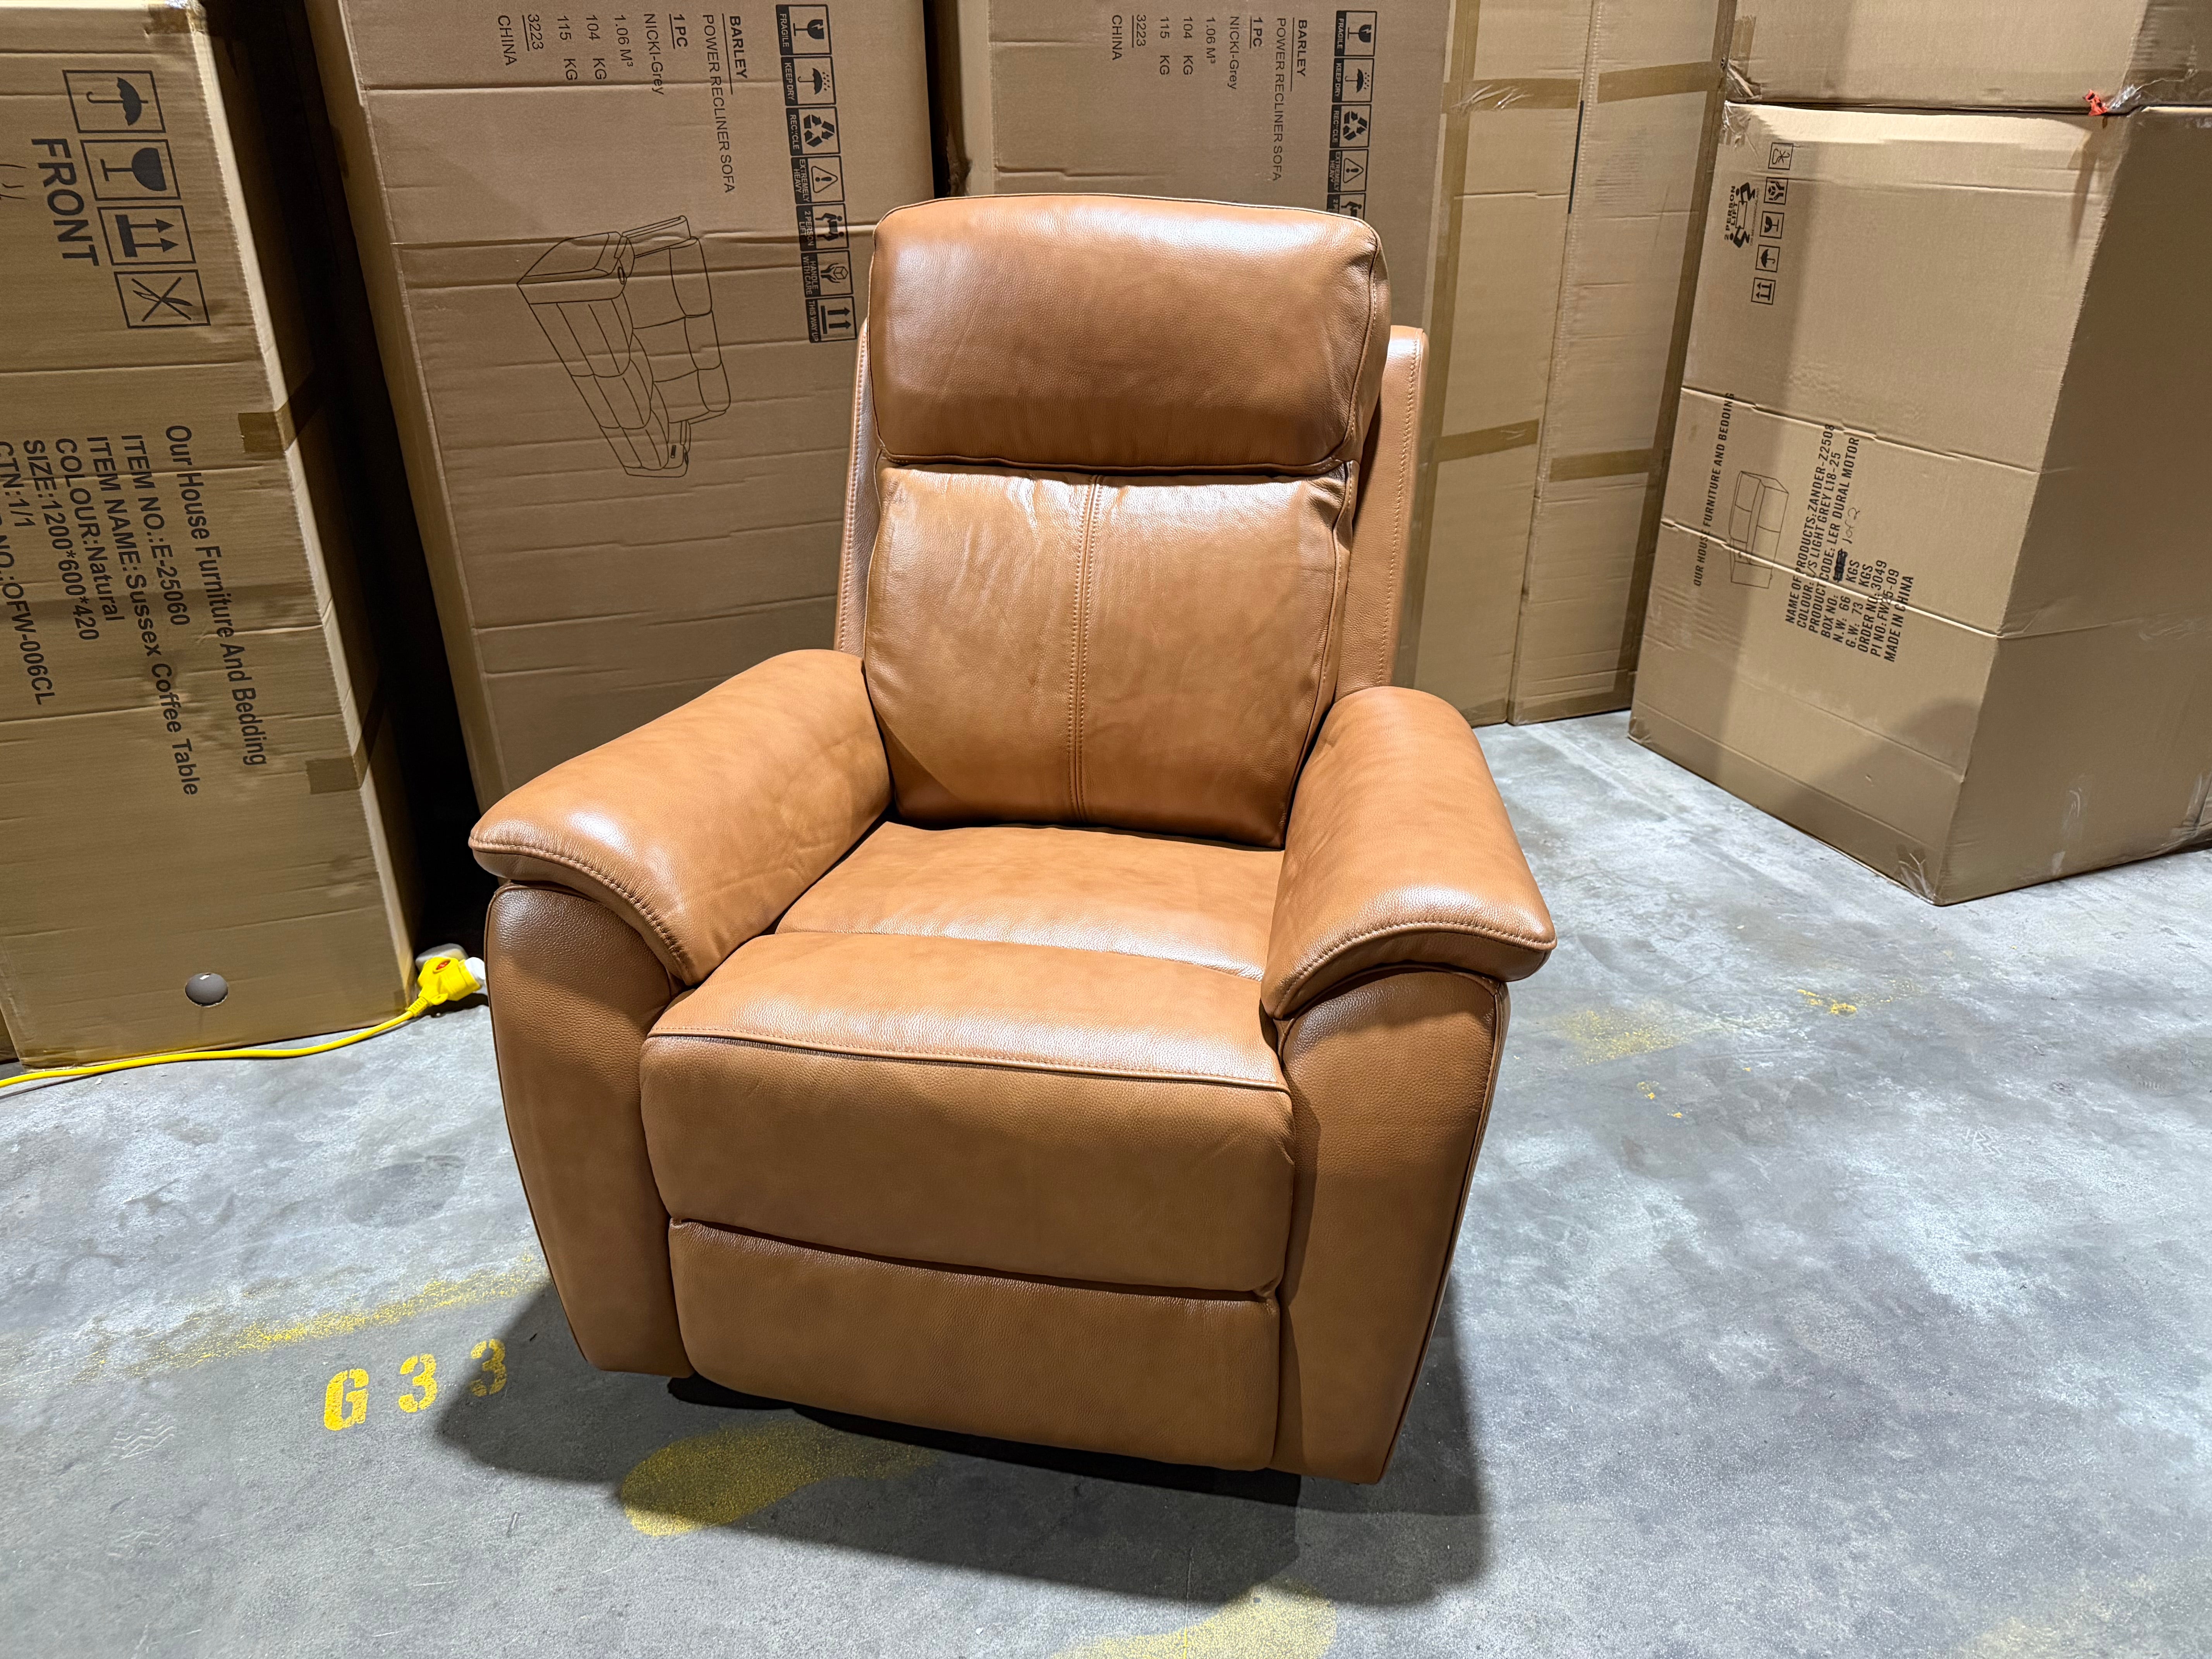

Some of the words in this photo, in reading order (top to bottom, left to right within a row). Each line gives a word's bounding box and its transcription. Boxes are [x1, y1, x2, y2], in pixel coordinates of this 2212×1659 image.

[498, 15, 517, 66] CHINA
[527, 14, 544, 50] 3223
[615, 15, 629, 45] 1.06
[675, 26, 687, 47] PC
[702, 14, 720, 72] POWER
[780, 14, 790, 48] FRAGILE
[1112, 15, 1122, 60] CHINA
[1136, 14, 1146, 46] 3223
[1160, 17, 1170, 39] 115
[1183, 17, 1193, 39] 104
[1206, 17, 1216, 44] 1.06
[1253, 28, 1262, 47] PC
[1275, 18, 1286, 70] POWER
[557, 15, 571, 40] 115
[564, 58, 578, 81] KG
[586, 15, 600, 41] 104
[593, 58, 607, 80] KG
[644, 14, 664, 95] NICKI-Grey
[730, 16, 747, 79] BARLEY
[1228, 17, 1239, 89] NICKI-Grey
[1297, 20, 1307, 77] BARLEY
[784, 62, 793, 83] KEEP
[1160, 55, 1170, 75] KG
[1183, 56, 1193, 75] KG
[787, 84, 795, 101] DRY
[1273, 74, 1284, 142] RECLINER
[710, 76, 730, 151] RECLINER
[721, 155, 735, 193] SOFA
[800, 159, 810, 202] EXTREMELY
[1273, 146, 1282, 181] SOFA
[793, 169, 802, 193] HEAVY
[31, 139, 100, 266] FRONT
[1726, 185, 1736, 231] PERSON
[805, 216, 814, 246] PERSON
[802, 256, 811, 274] WITH
[810, 261, 819, 290] HANDLE
[804, 275, 812, 295] CARE
[812, 332, 819, 342] UP
[1718, 393, 1734, 440] BEDDING
[122, 435, 155, 489] ITEM
[166, 426, 192, 465] Our
[1714, 444, 1725, 466] AND
[1841, 437, 1860, 478] MOTOR
[0, 441, 36, 527] CTN:1/1
[1824, 452, 1841, 491] L18-25
[177, 472, 204, 539] House
[1703, 468, 1721, 527] FURNITURE
[1817, 493, 1832, 523] GREY
[1832, 482, 1850, 519] DURAL
[55, 438, 125, 621] COLOUR:Natural
[1697, 529, 1710, 563] HOUSE
[1810, 524, 1825, 558] LIGHT
[1826, 523, 1841, 544] LER
[138, 497, 190, 625] NO.:E-25060
[1693, 565, 1704, 586] OUR
[1807, 560, 1817, 578] /S
[1819, 548, 1835, 581] CODE:
[1845, 560, 1860, 583] KGS
[1858, 564, 1873, 587] KGS
[1871, 560, 1887, 591] 3049
[195, 546, 234, 638] Furniture
[1791, 575, 1802, 590] OF
[1894, 576, 1914, 612] CHINA
[87, 437, 121, 491] ITEM
[104, 500, 161, 657] NAME:Sussex
[151, 663, 182, 733] Coffee
[172, 738, 200, 795] Table
[1785, 591, 1800, 623] NAME
[1796, 582, 1814, 629] COLOUR:
[1808, 581, 1827, 633] PRODUCT
[1825, 595, 1838, 614] NO:
[1839, 596, 1850, 611] 66
[1851, 602, 1863, 615] 73
[1865, 594, 1880, 613] NO:
[1820, 615, 1834, 638] BOX
[1832, 618, 1847, 643] N.W:
[1845, 623, 1860, 648] G.W:
[1858, 615, 1874, 653] ORDER
[1891, 614, 1904, 628] IN
[1870, 644, 1882, 657] PI
[1884, 629, 1901, 662] MADE
[220, 644, 252, 682] And
[232, 688, 267, 766] Bedding
